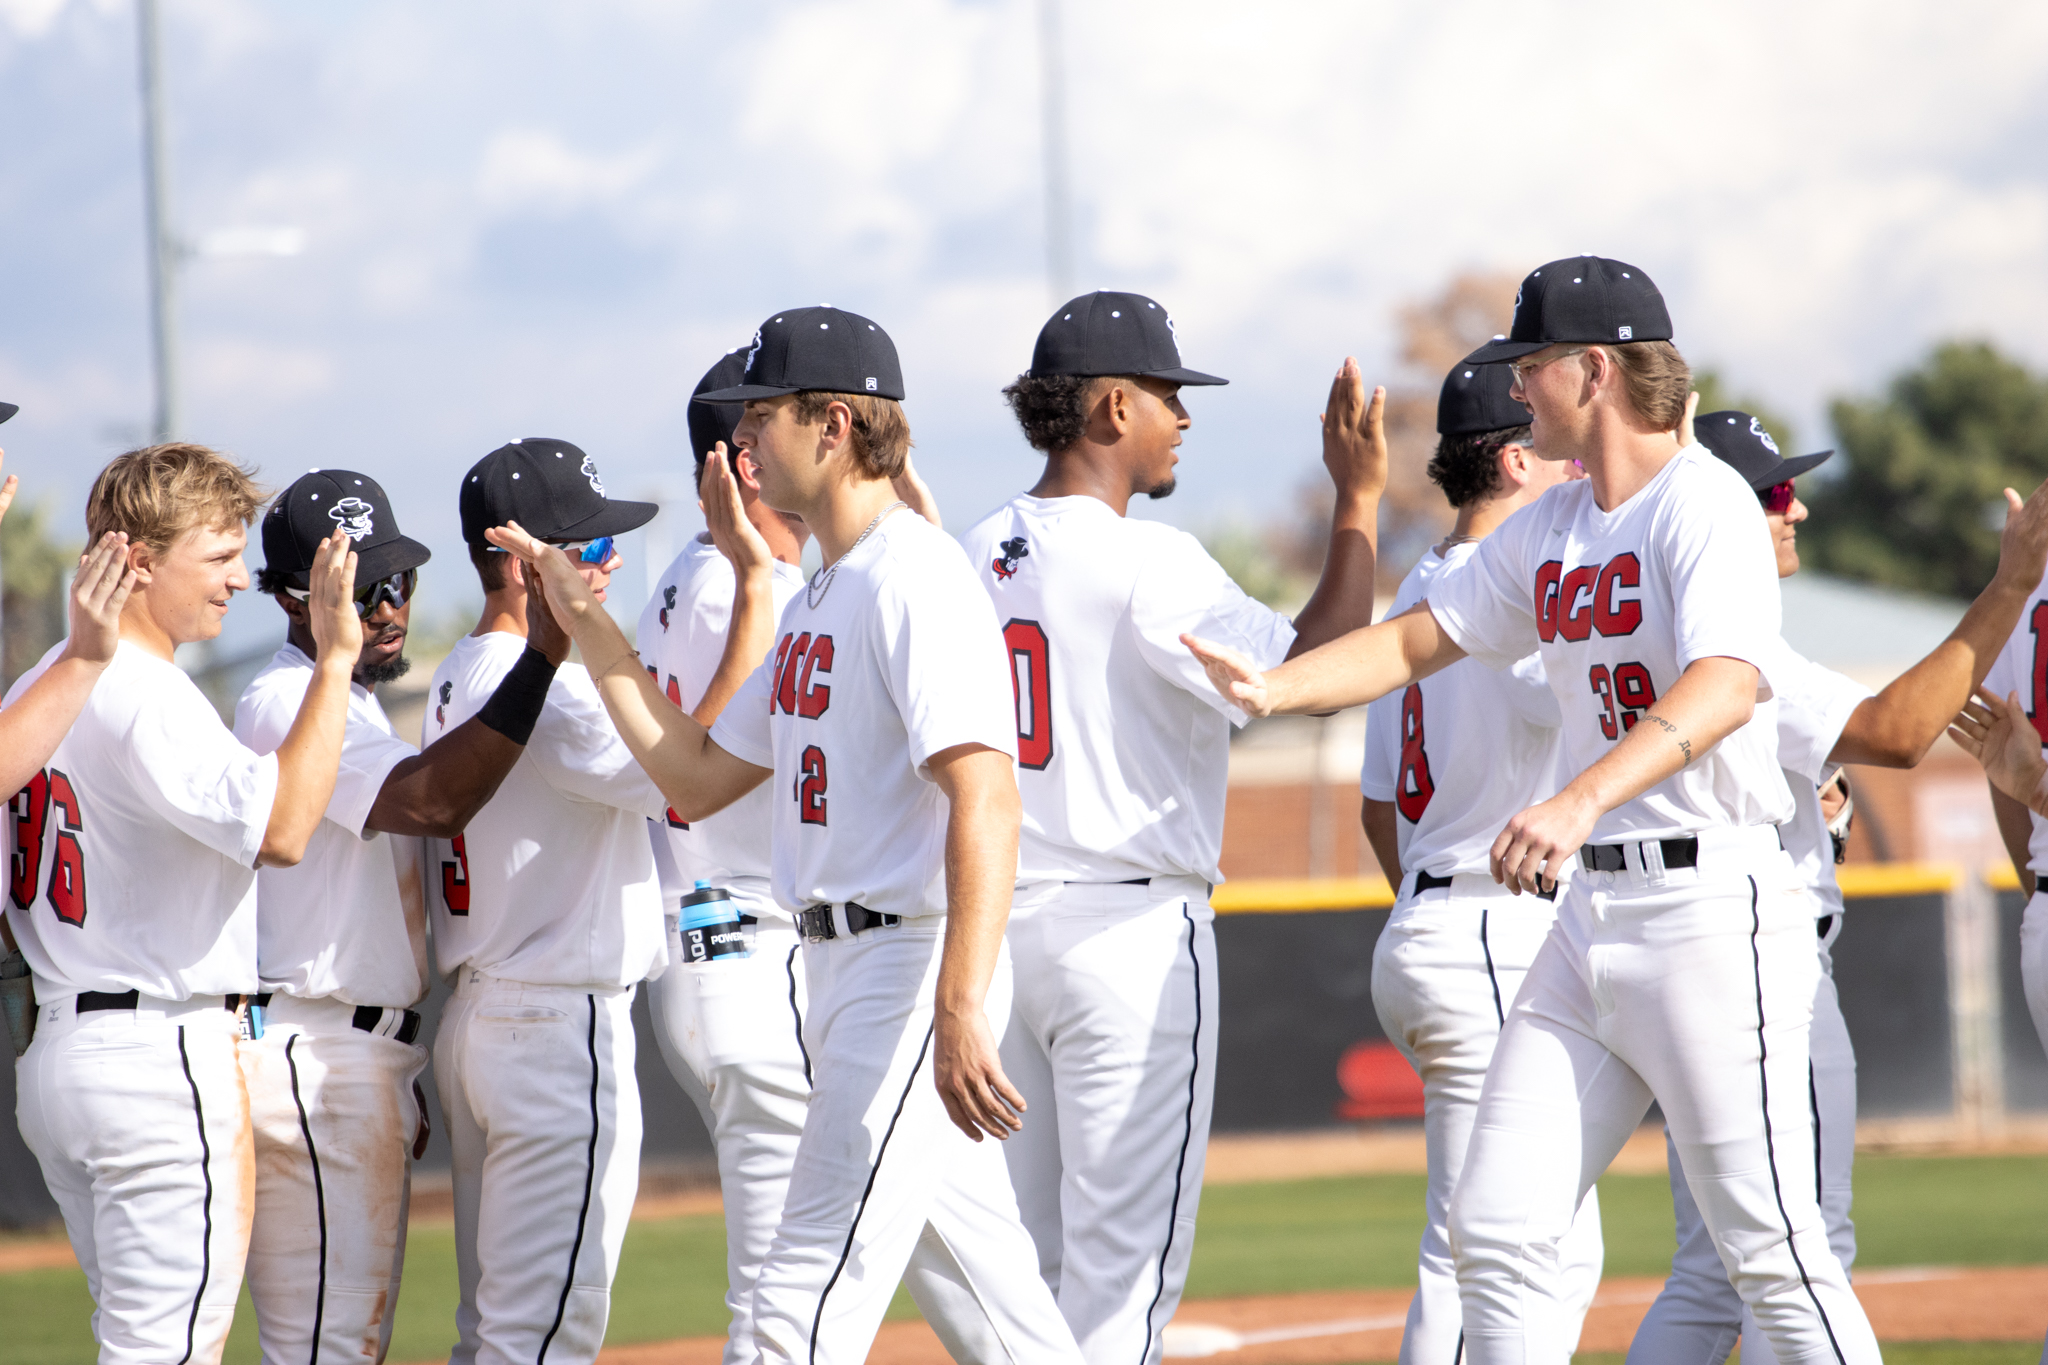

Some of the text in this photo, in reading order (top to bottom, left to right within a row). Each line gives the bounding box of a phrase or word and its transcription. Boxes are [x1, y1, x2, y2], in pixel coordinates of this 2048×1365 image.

[1534, 551, 1643, 643] GCC
[1002, 617, 1053, 771] 0
[1589, 661, 1657, 740] 39
[793, 744, 827, 826] 2
[1396, 682, 1435, 824] 8
[9, 767, 87, 929] 36
